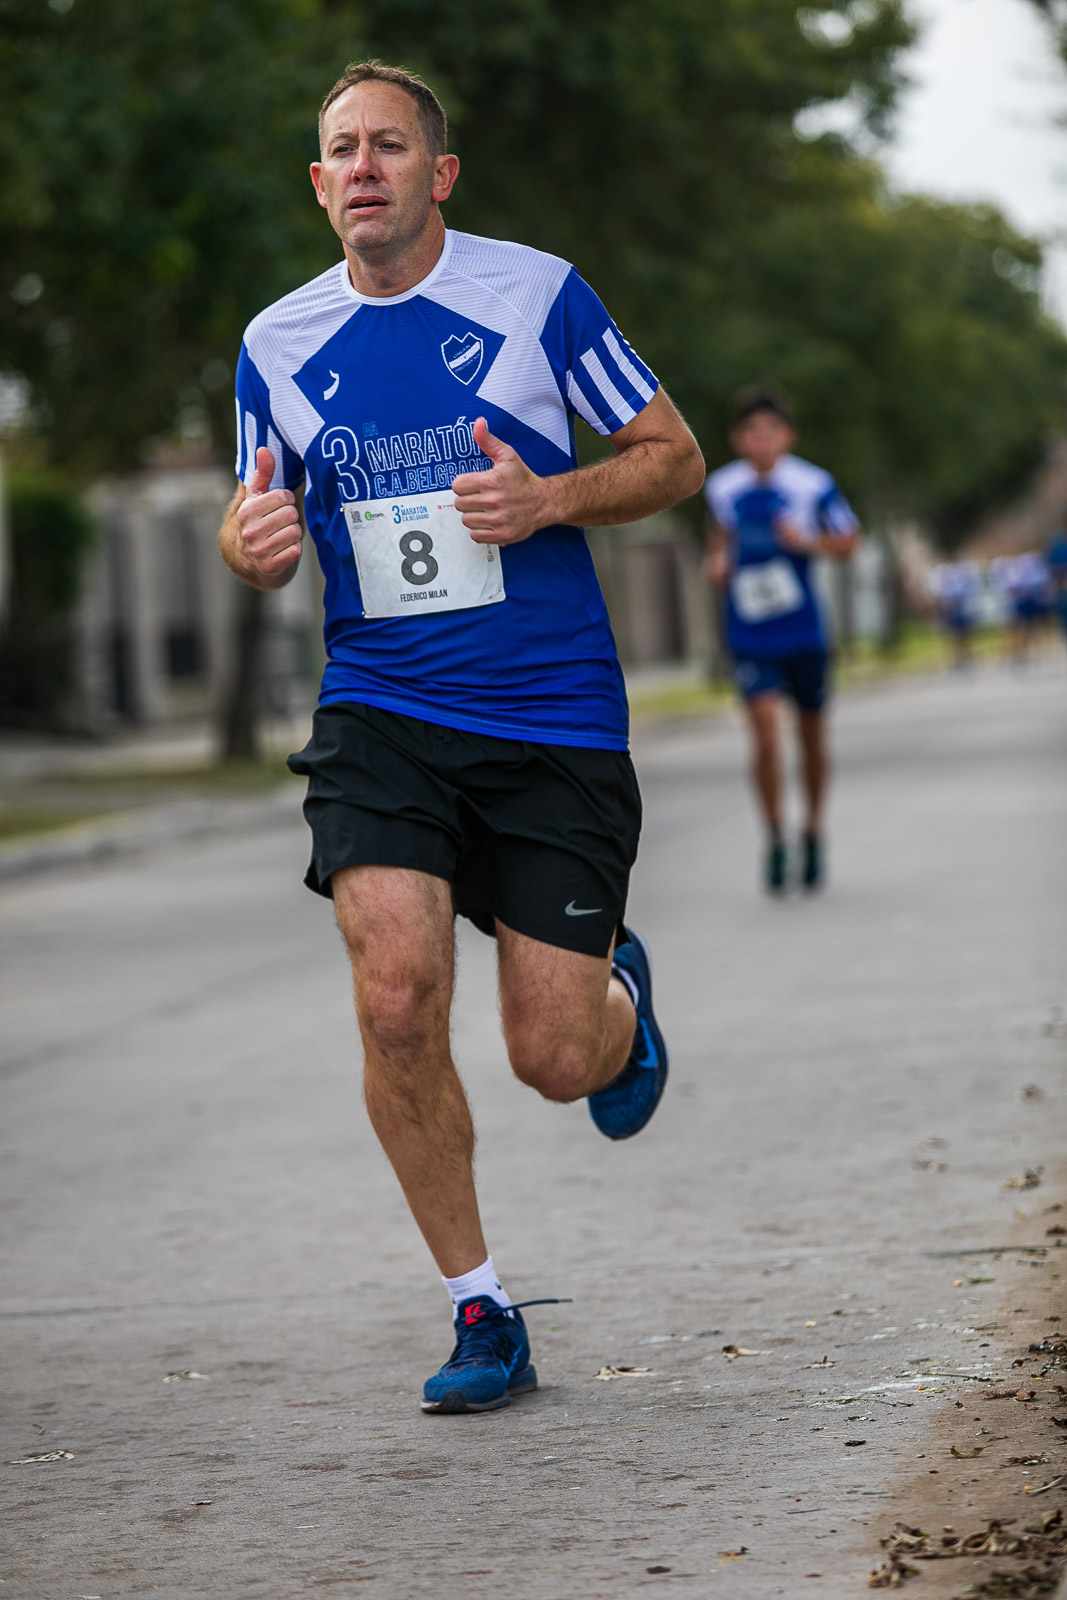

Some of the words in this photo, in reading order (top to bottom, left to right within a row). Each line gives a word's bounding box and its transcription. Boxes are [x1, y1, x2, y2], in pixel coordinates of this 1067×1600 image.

[321, 426, 370, 500] 3
[392, 505, 401, 524] 3
[399, 530, 439, 585] 8
[400, 591, 427, 602] FEDERICO
[428, 588, 448, 599] MILAN
